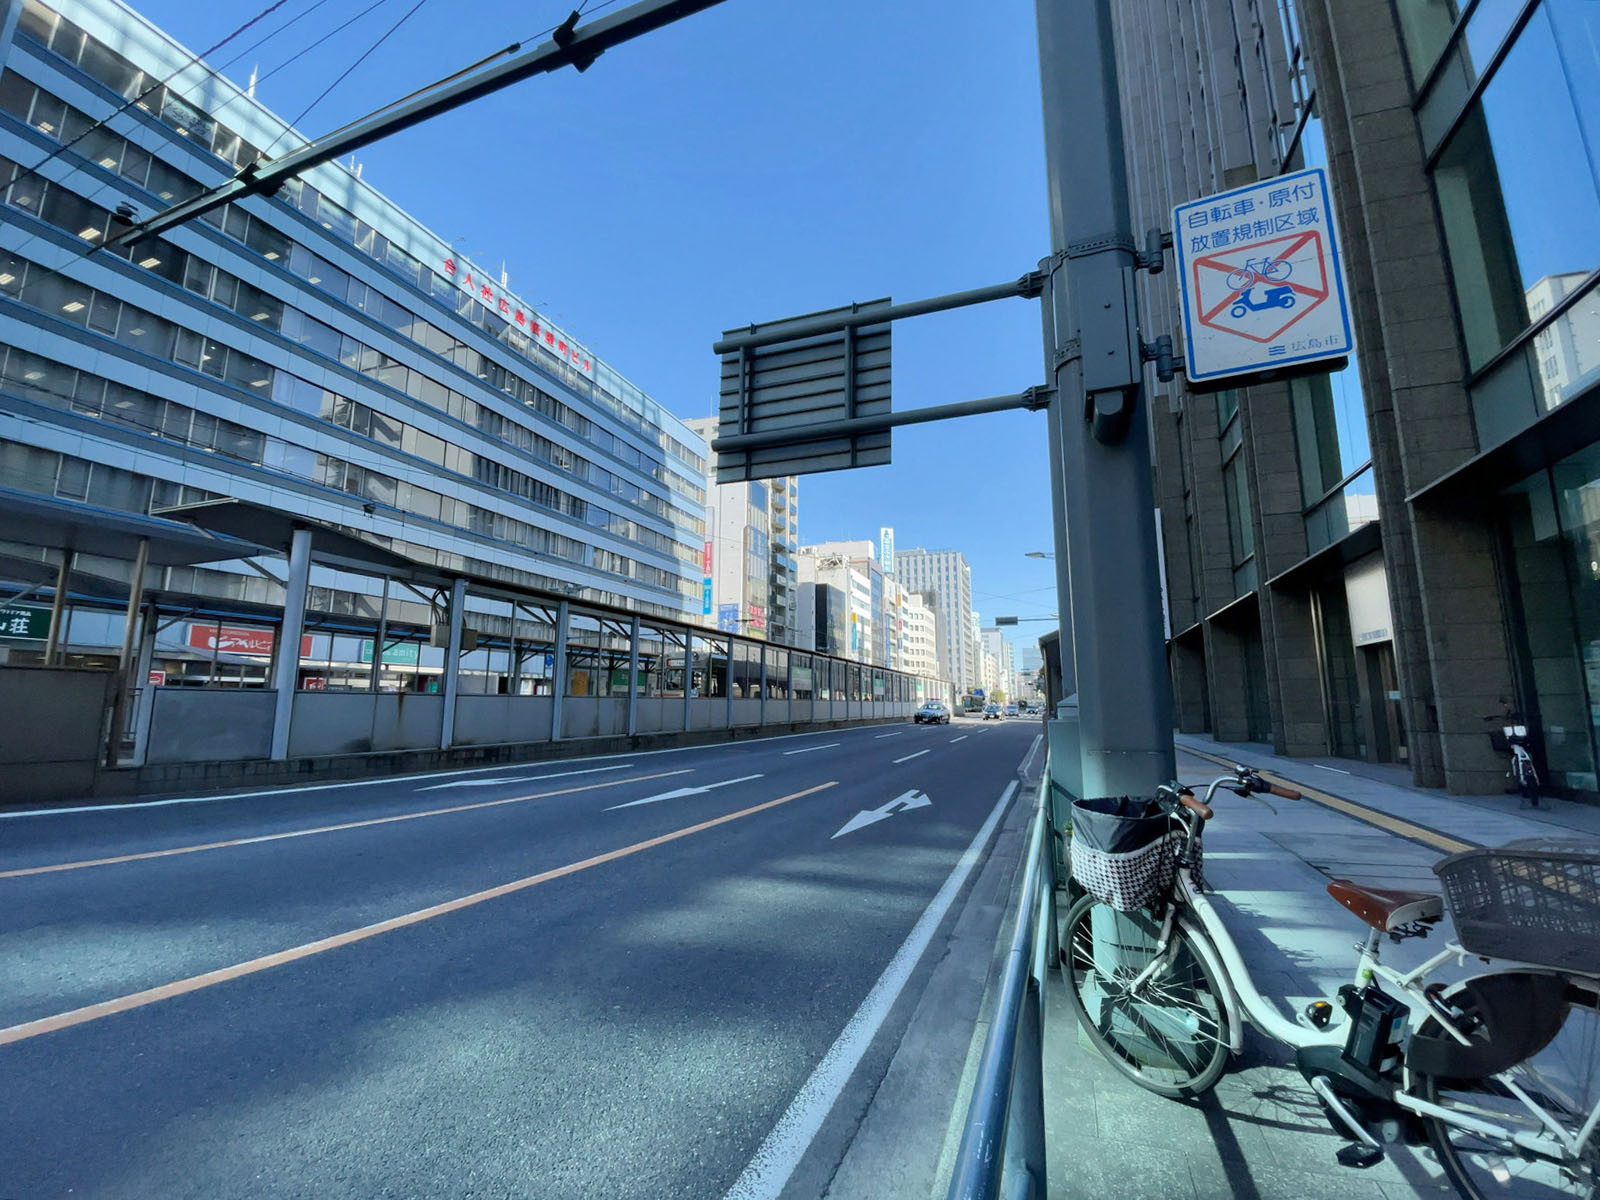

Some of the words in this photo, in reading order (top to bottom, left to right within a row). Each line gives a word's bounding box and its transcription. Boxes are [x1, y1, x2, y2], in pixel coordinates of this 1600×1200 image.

[1188, 181, 1316, 229] 自転車・原付
[1191, 207, 1320, 254] 放置規制区域
